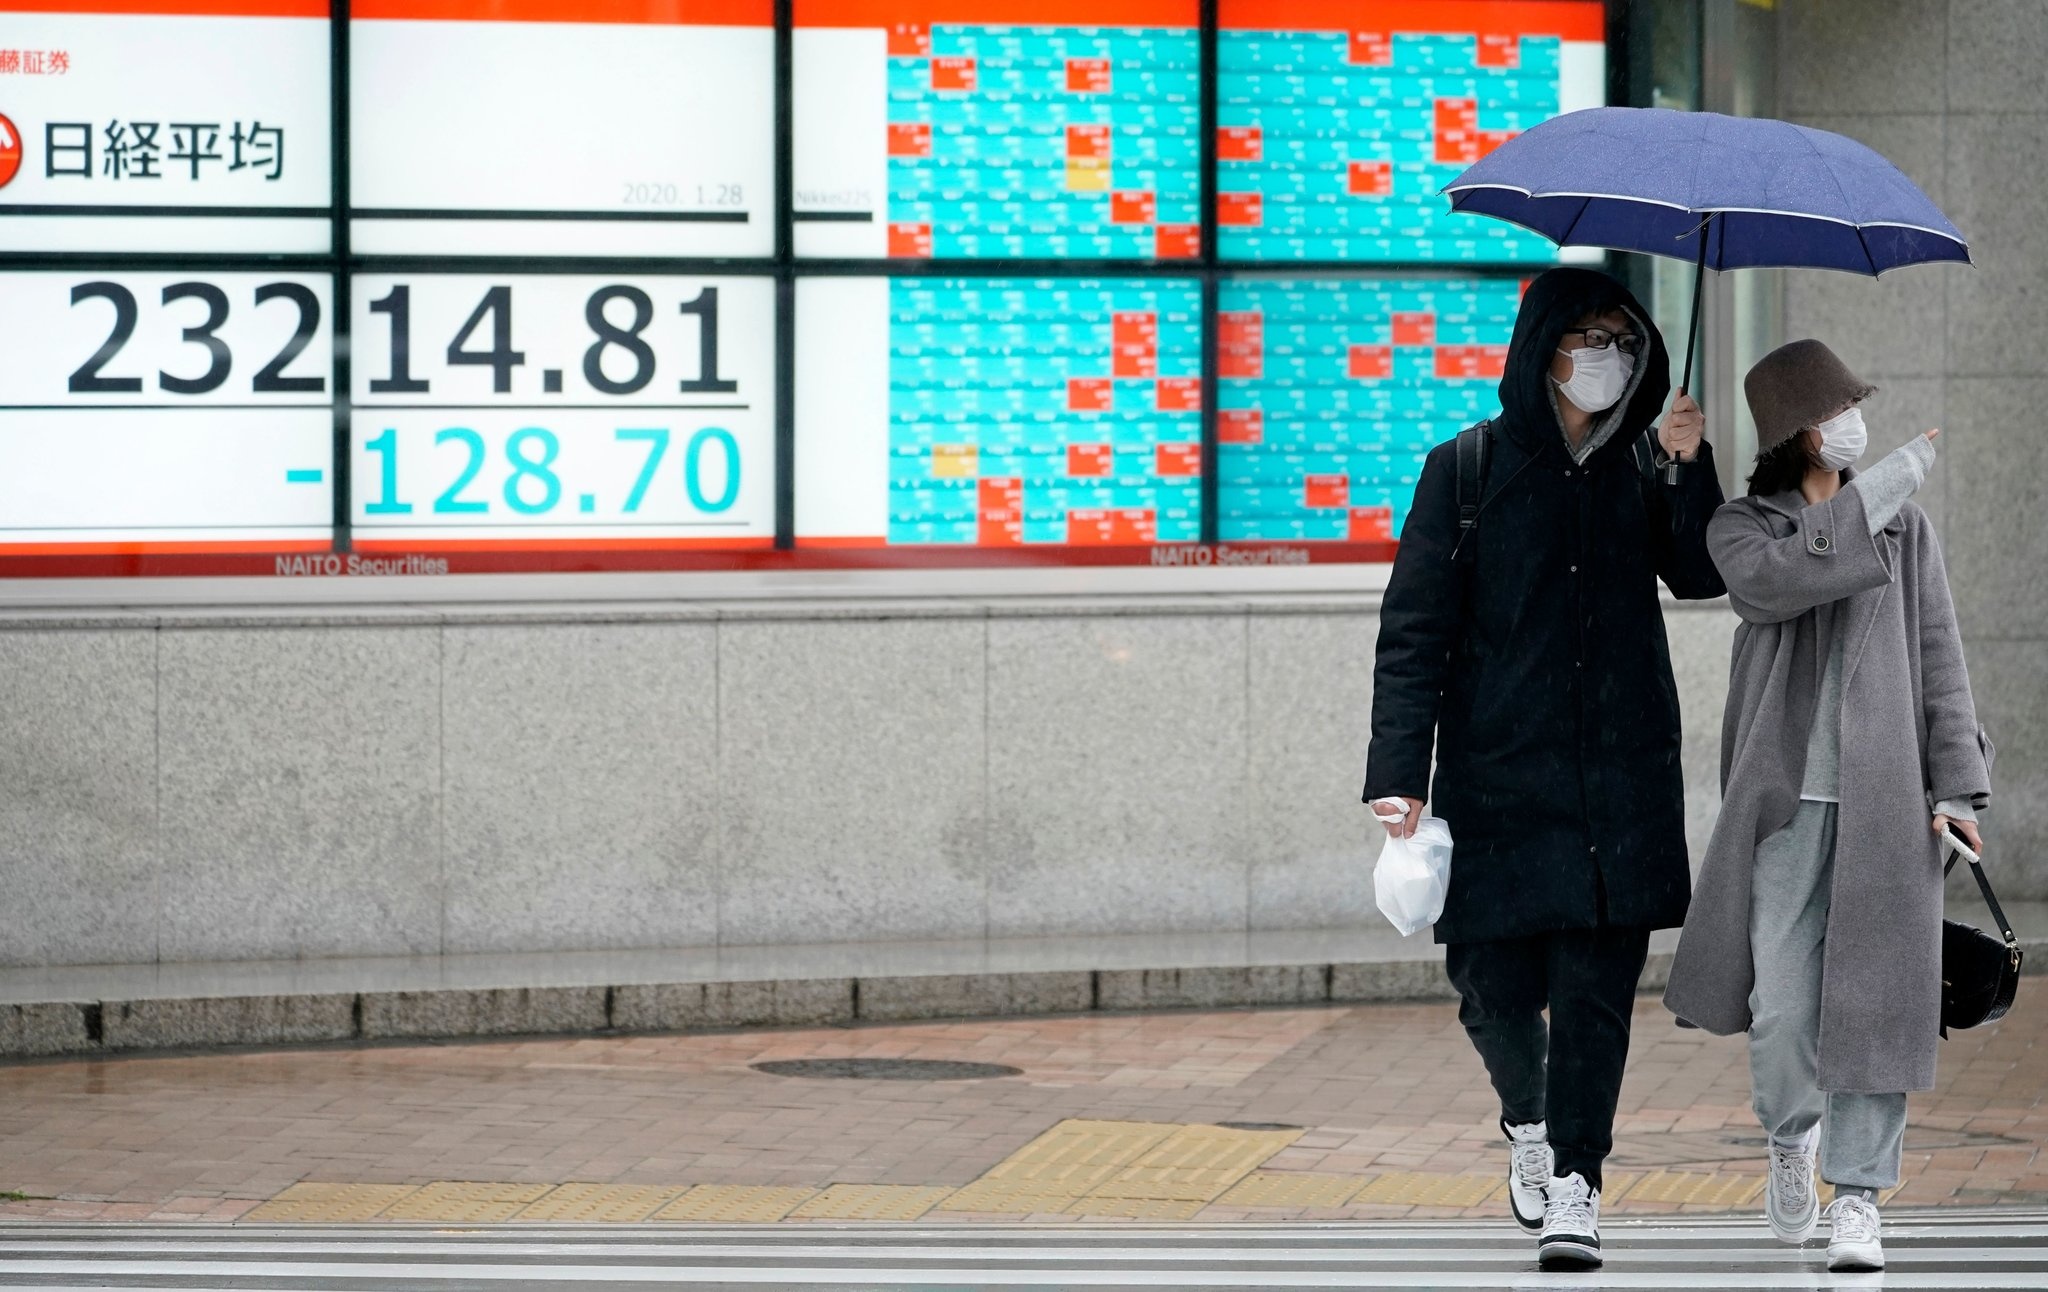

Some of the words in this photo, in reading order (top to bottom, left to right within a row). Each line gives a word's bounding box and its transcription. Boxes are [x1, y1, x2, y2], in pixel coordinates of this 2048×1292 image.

[46, 119, 284, 181] 日経平均
[68, 281, 738, 395] 23214.81
[275, 554, 341, 576] NAITO
[346, 554, 448, 576] Securities
[1150, 546, 1212, 567] NAITO
[1216, 546, 1310, 566] Securities
